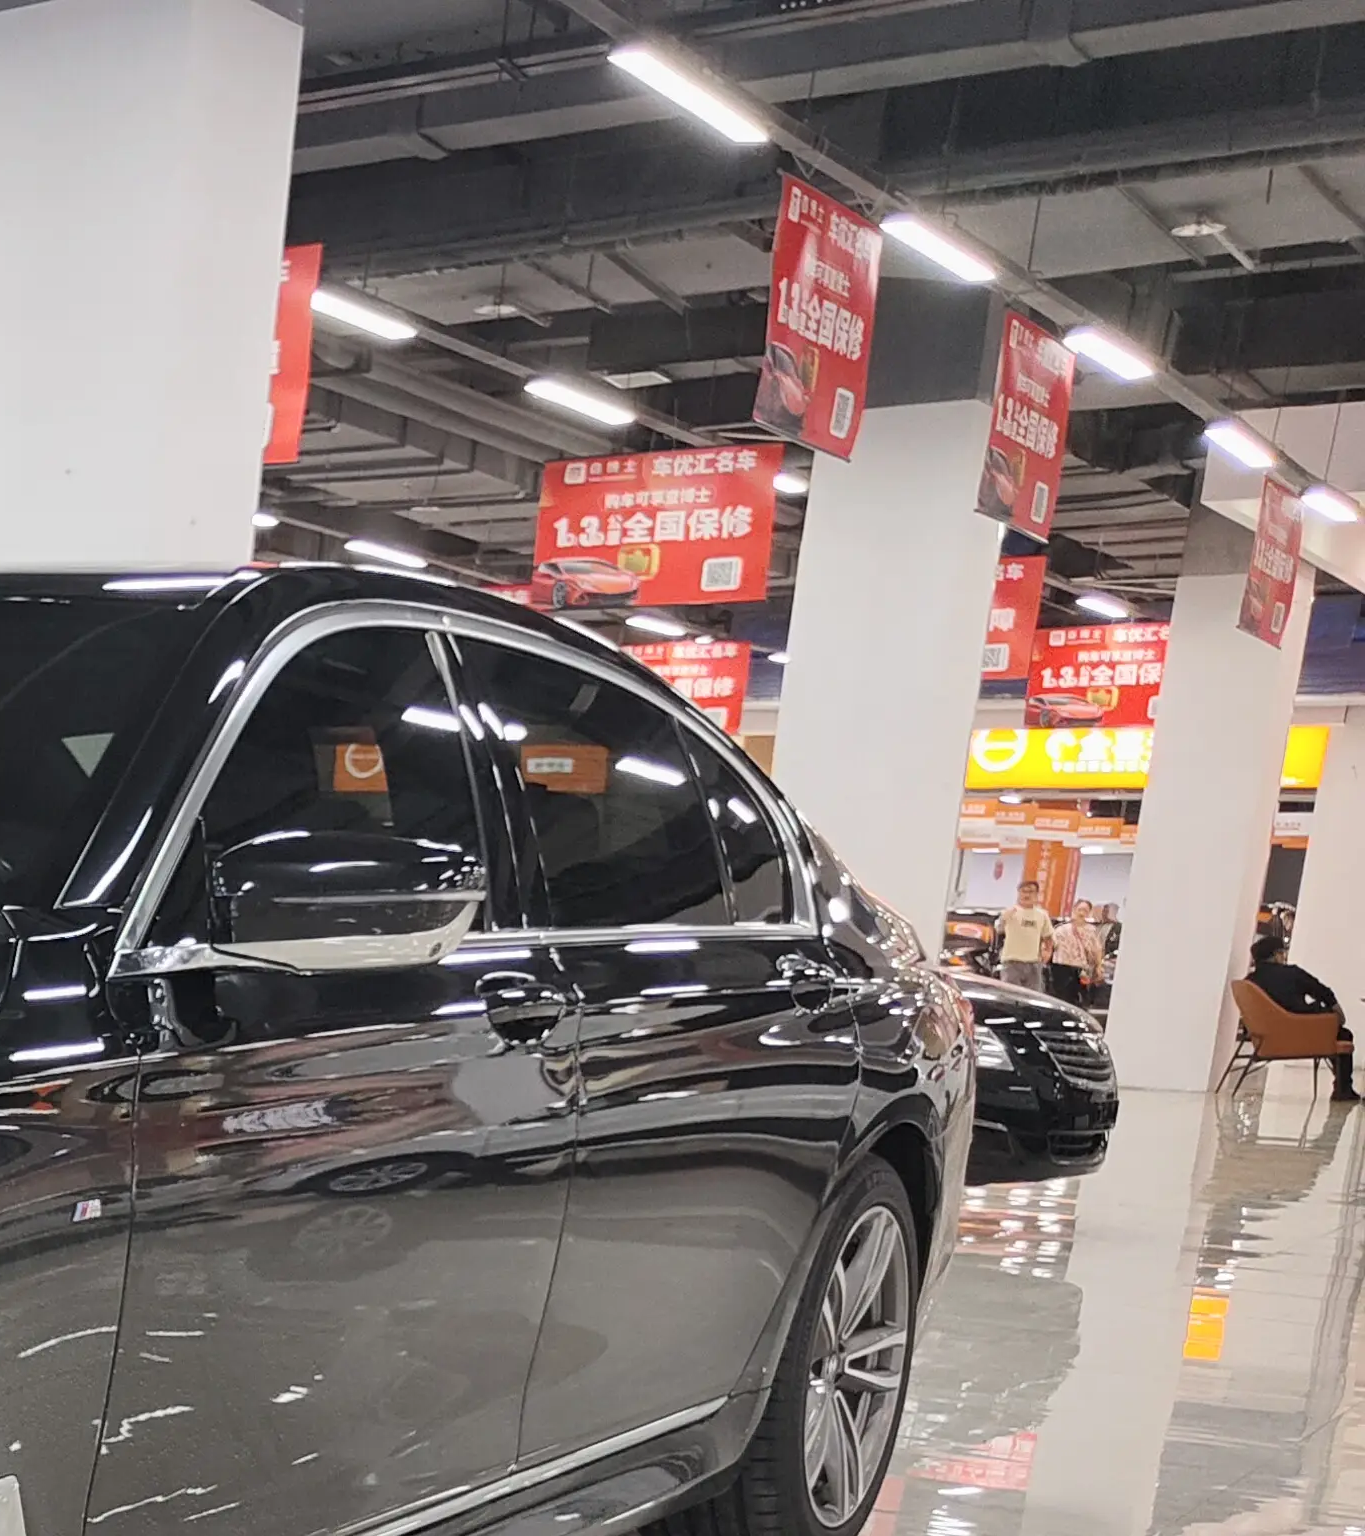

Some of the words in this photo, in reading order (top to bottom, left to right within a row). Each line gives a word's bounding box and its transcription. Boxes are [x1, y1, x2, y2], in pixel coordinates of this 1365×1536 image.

[651, 449, 758, 477] 车优汇名车
